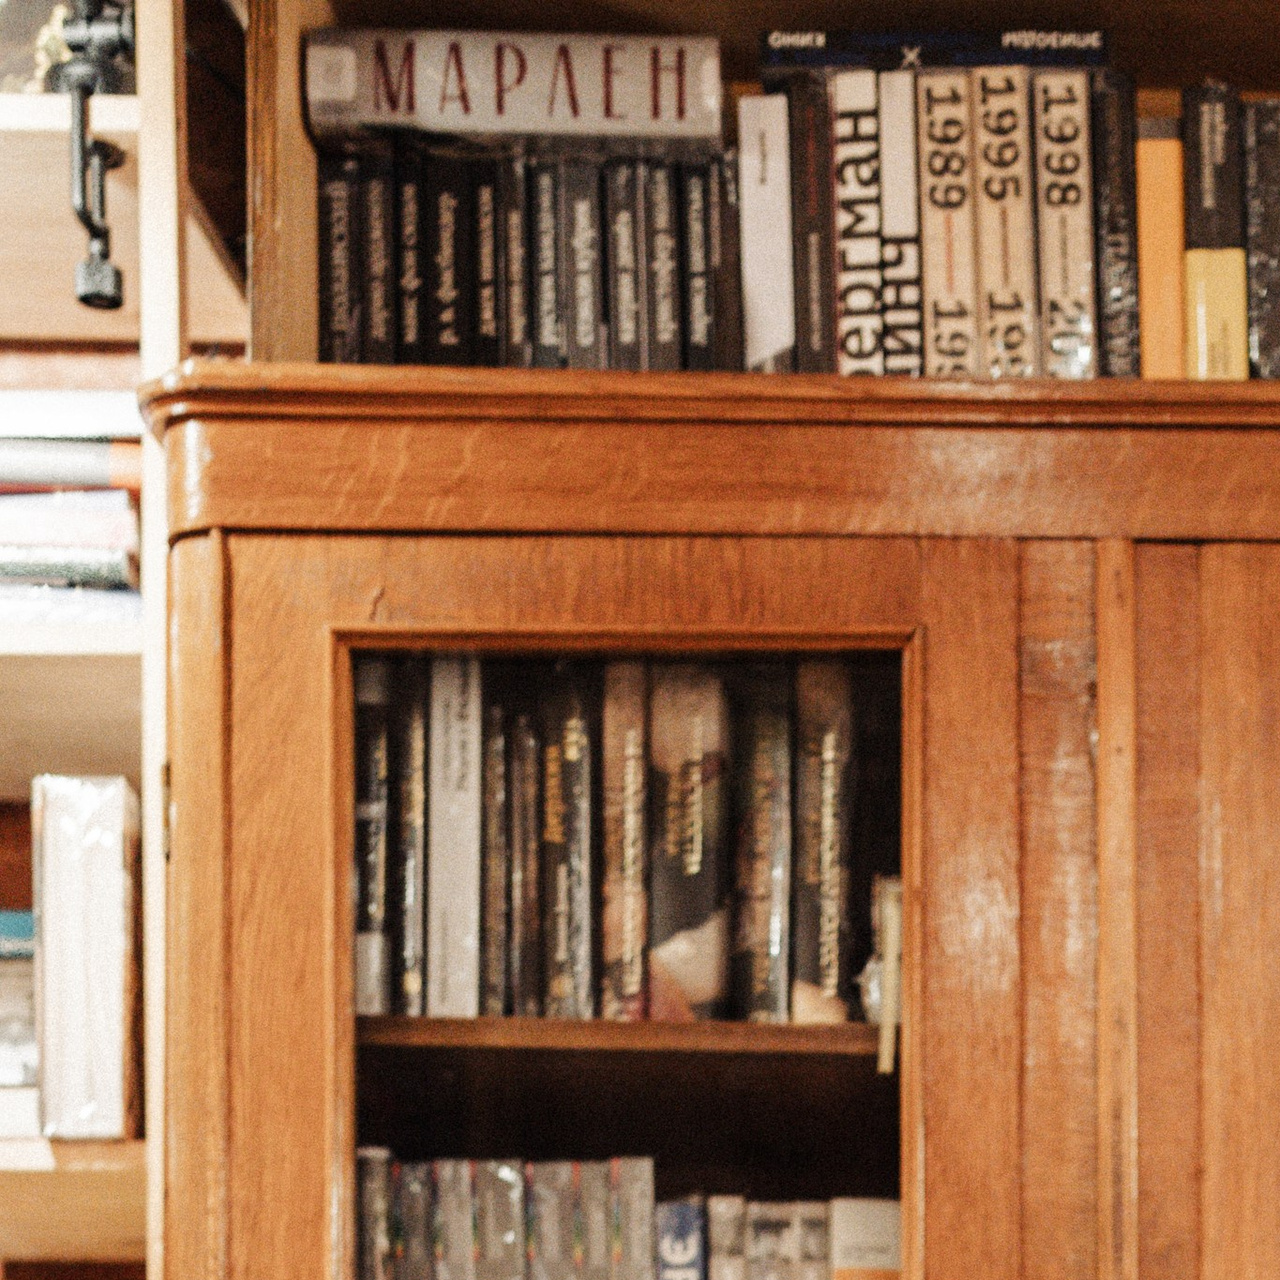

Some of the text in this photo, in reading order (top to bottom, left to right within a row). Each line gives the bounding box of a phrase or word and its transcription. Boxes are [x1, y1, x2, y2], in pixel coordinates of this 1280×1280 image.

[373, 41, 688, 121] МАРЛЕН
[980, 76, 1021, 202] 1995
[927, 86, 967, 210] 1989
[1043, 85, 1083, 207] 1998
